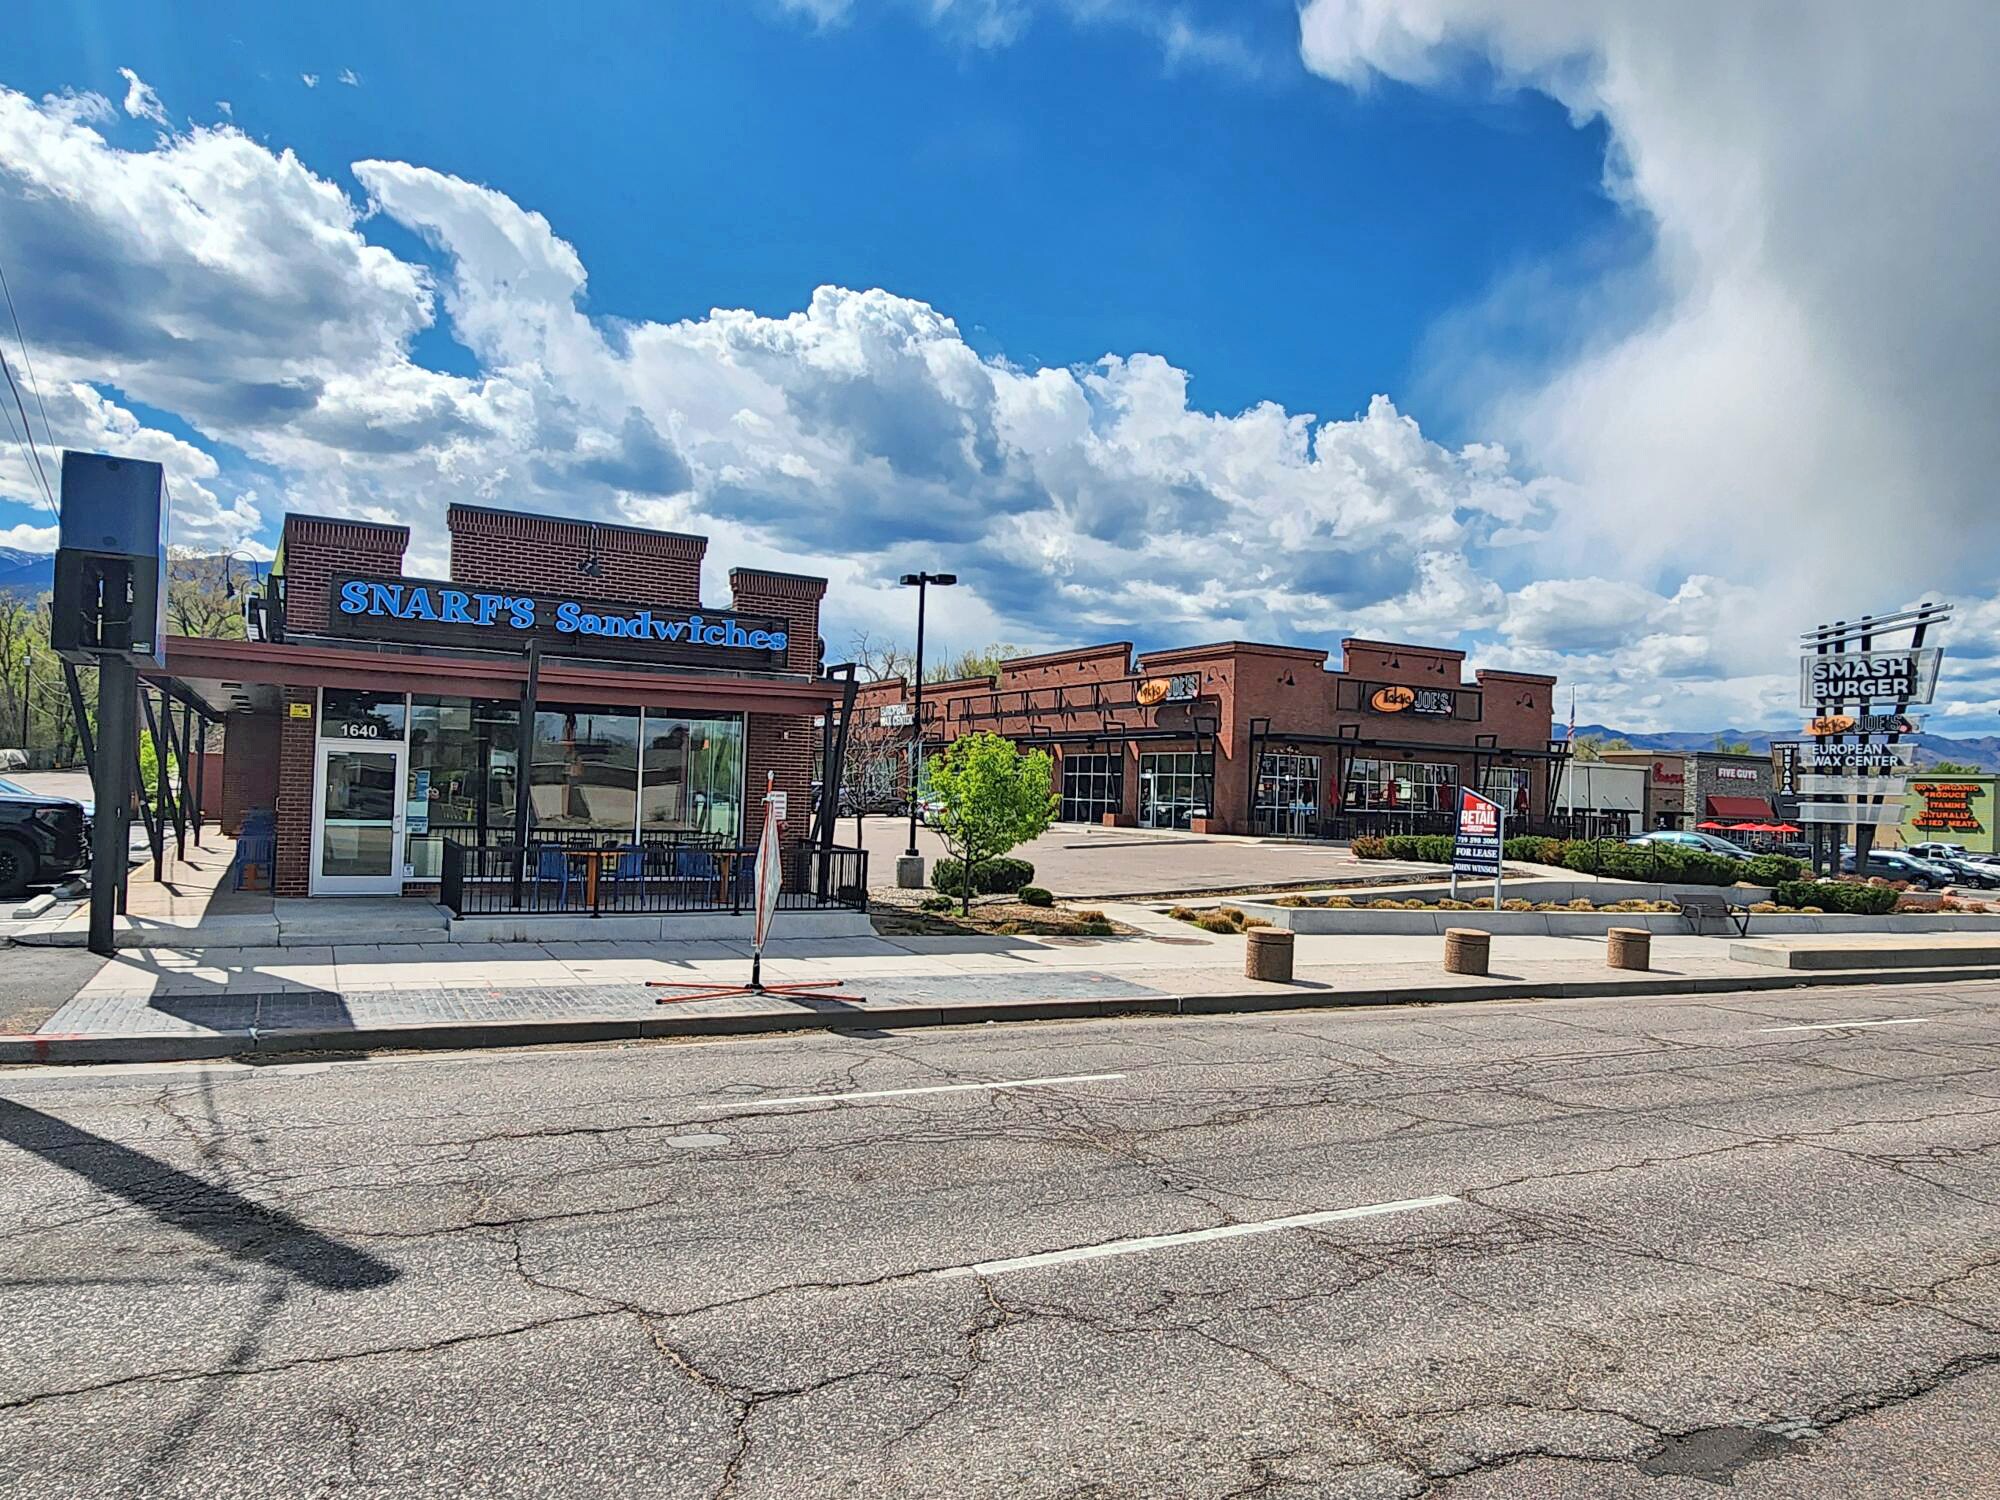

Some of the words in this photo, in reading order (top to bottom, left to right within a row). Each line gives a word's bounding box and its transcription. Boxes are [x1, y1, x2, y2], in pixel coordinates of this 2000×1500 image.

[339, 581, 536, 630] SNARF'S
[555, 602, 788, 650] Sandwiches
[1813, 658, 1908, 680] SMASH
[1813, 678, 1908, 698] BURGER
[1414, 690, 1449, 710] JOE'S
[1854, 714, 1902, 732] JOE'S
[340, 723, 378, 738] 1640
[1812, 743, 1883, 755] EUROPEAN
[1812, 755, 1842, 767] WAX
[1845, 755, 1898, 767] CENTER
[1718, 767, 1736, 778] FIVE
[1736, 769, 1758, 780] GUYS
[1783, 748, 1791, 791] NEVADA
[1924, 791, 1967, 799] PRODUCE
[1936, 784, 1979, 792] ORGANIC
[1461, 811, 1496, 825] RETAIL
[1947, 820, 1979, 828] MEATS
[1456, 848, 1472, 857] FOR
[1473, 849, 1497, 858] LEASE
